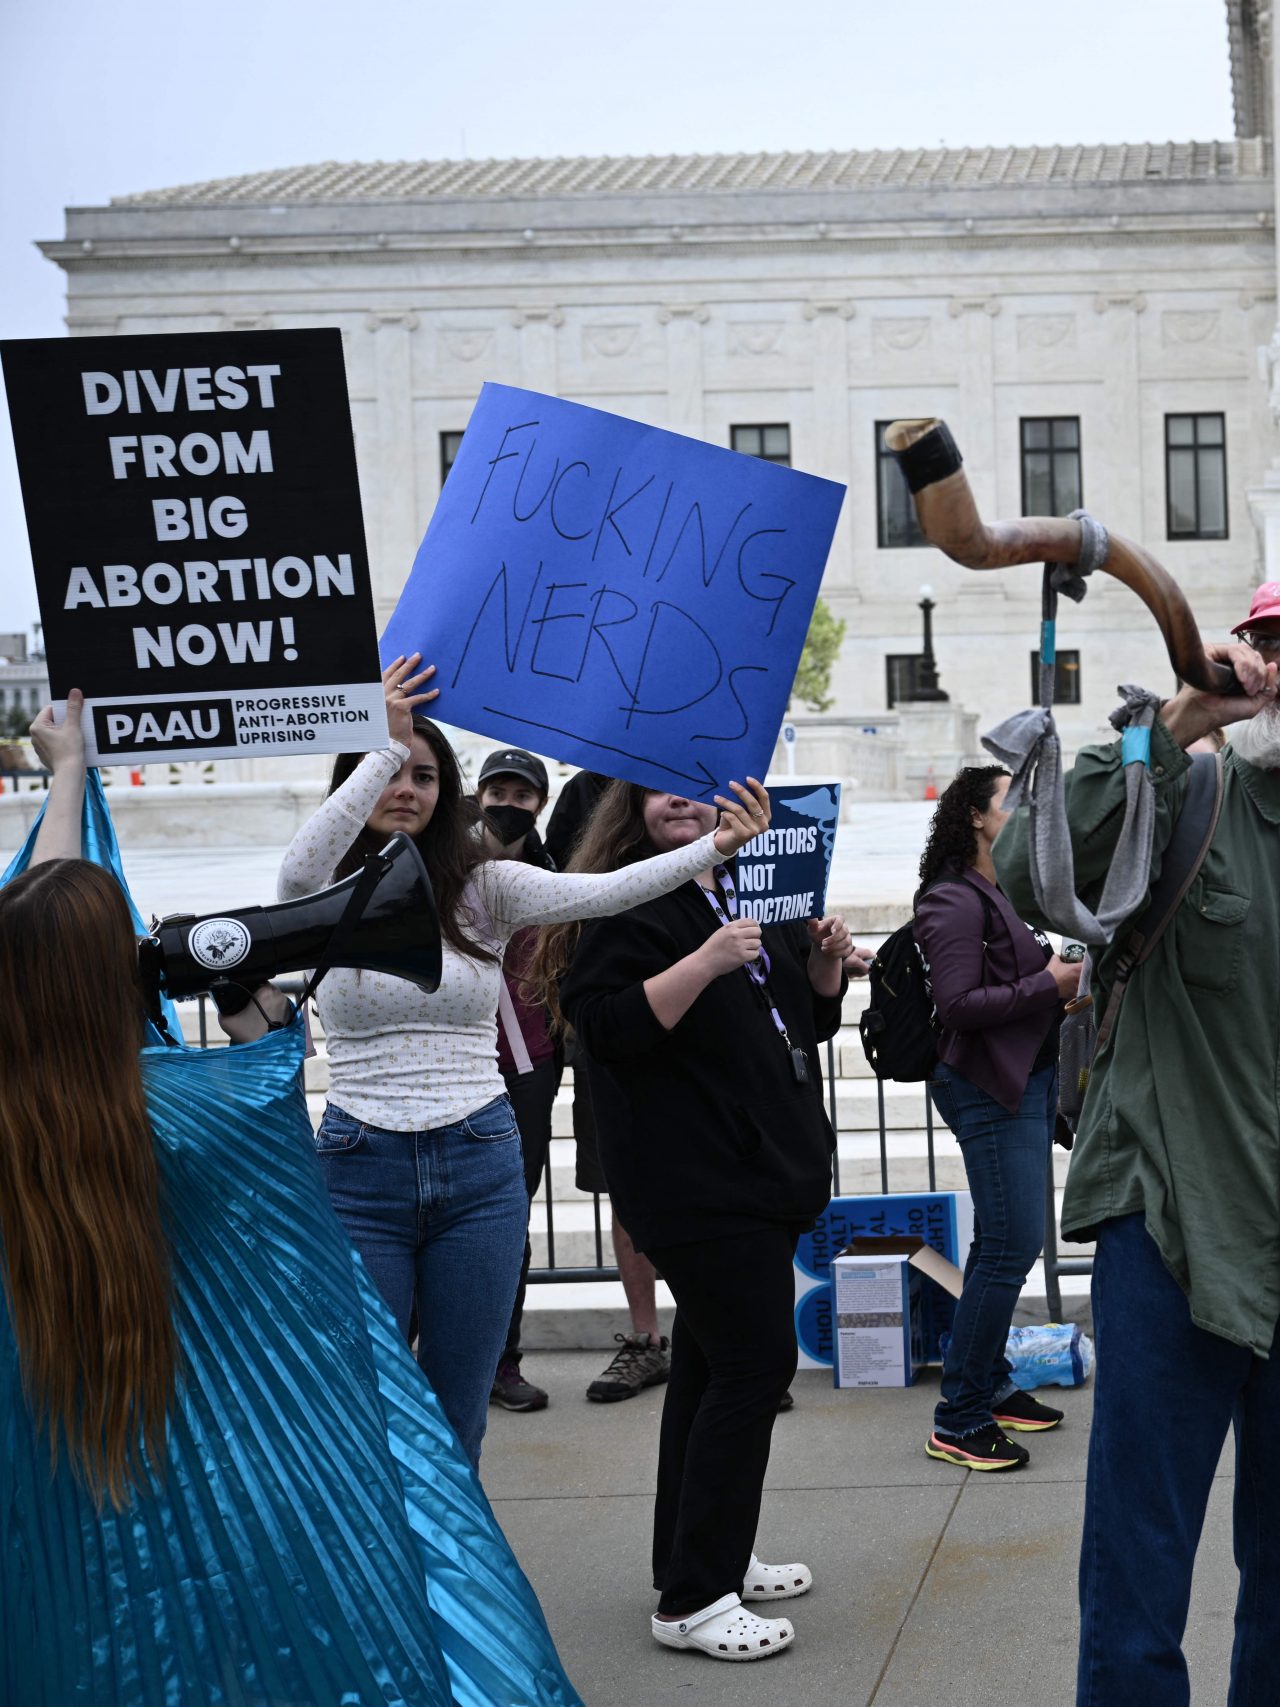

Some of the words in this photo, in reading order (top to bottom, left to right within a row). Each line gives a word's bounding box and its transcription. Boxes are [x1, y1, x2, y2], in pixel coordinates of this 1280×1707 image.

[81, 365, 281, 415] DIVEST
[108, 430, 273, 479] FROM
[152, 496, 248, 541] BIG
[471, 421, 797, 637] FUCKING
[64, 554, 355, 609] ABORTION
[132, 617, 298, 669] NOW!
[451, 561, 769, 742] NERDS
[106, 708, 221, 744] PAAU
[236, 695, 346, 712] PROGRESSIVE
[238, 710, 369, 728] ANTI-ABORTION
[240, 729, 316, 744] UPRISING
[739, 864, 775, 892] NOT
[740, 891, 815, 925] DOCTRINE
[830, 1212, 847, 1248] ALT
[927, 1203, 944, 1251] GHTS
[816, 1300, 832, 1353] THOU
